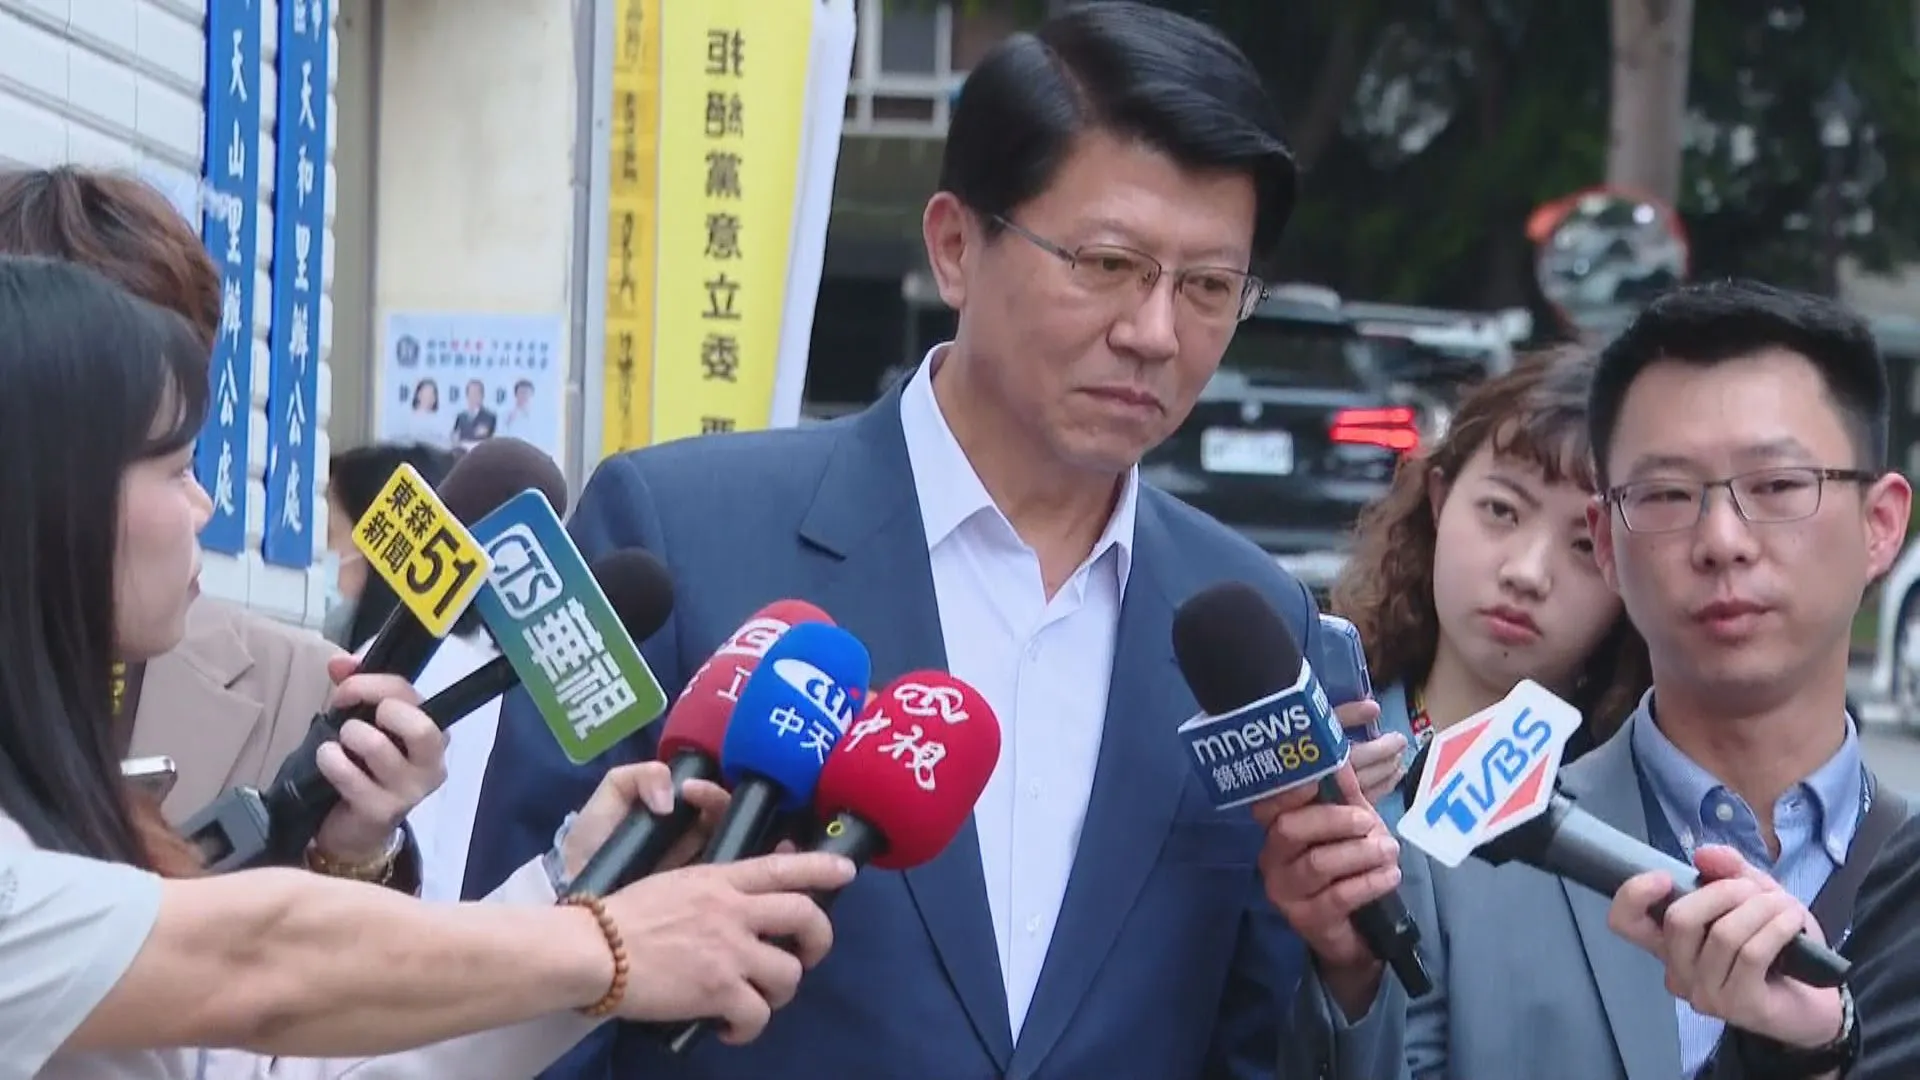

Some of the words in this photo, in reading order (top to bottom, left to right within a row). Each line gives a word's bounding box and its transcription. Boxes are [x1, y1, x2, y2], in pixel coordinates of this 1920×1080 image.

[214, 29, 248, 516] 天山里辦公處
[282, 60, 316, 533] 天和里辦公處
[385, 476, 436, 541] 東森
[362, 511, 415, 575] 新聞
[405, 528, 478, 620] 51
[488, 533, 557, 611] CTS
[521, 596, 638, 741] 華視
[769, 706, 835, 765] 中天
[845, 709, 946, 790] 中視
[1192, 704, 1312, 765] mnews
[1212, 747, 1285, 794] 鏡新聞
[1277, 735, 1320, 770] 86
[1425, 706, 1552, 834] TVBS
